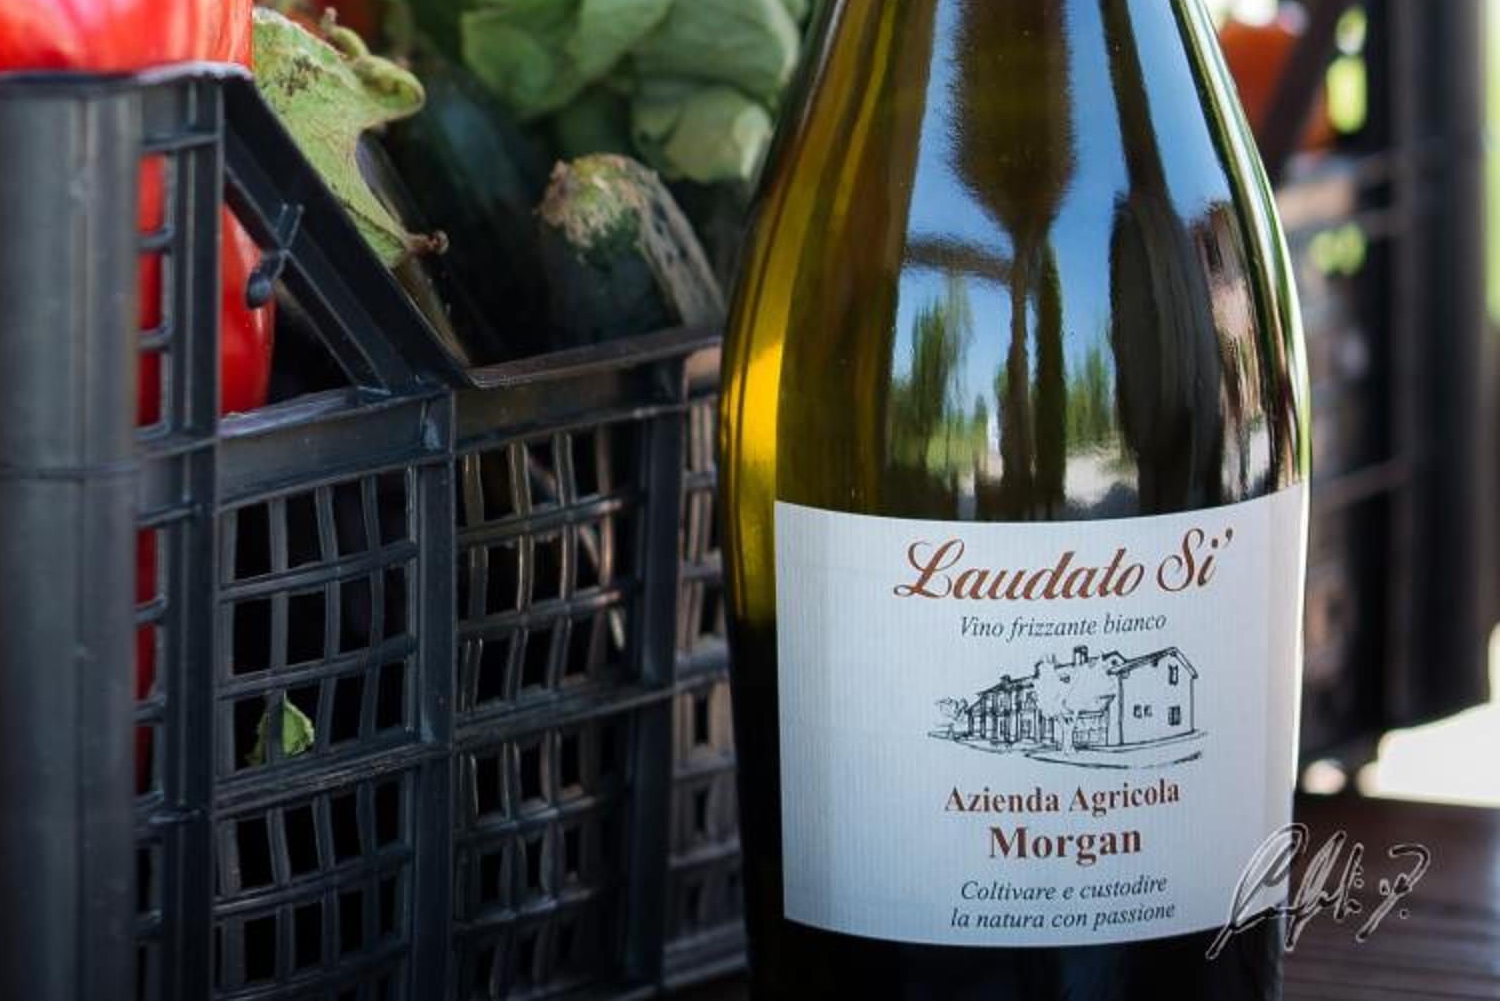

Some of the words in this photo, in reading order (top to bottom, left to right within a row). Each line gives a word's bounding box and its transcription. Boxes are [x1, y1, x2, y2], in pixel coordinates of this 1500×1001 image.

[893, 538, 1145, 601] Laudato
[960, 616, 1004, 638] Vino
[1006, 614, 1097, 643] frizzante
[1103, 613, 1168, 633] bianco
[945, 785, 1060, 813] Azienda
[1069, 778, 1181, 818] Agricola
[989, 825, 1142, 867] Morgan
[961, 880, 1057, 901] Coltivare
[1062, 885, 1075, 900] e
[1080, 874, 1168, 899] custodire
[951, 907, 971, 928] la
[976, 912, 1045, 929] natura
[1051, 911, 1088, 929] con
[1093, 902, 1176, 933] passione
